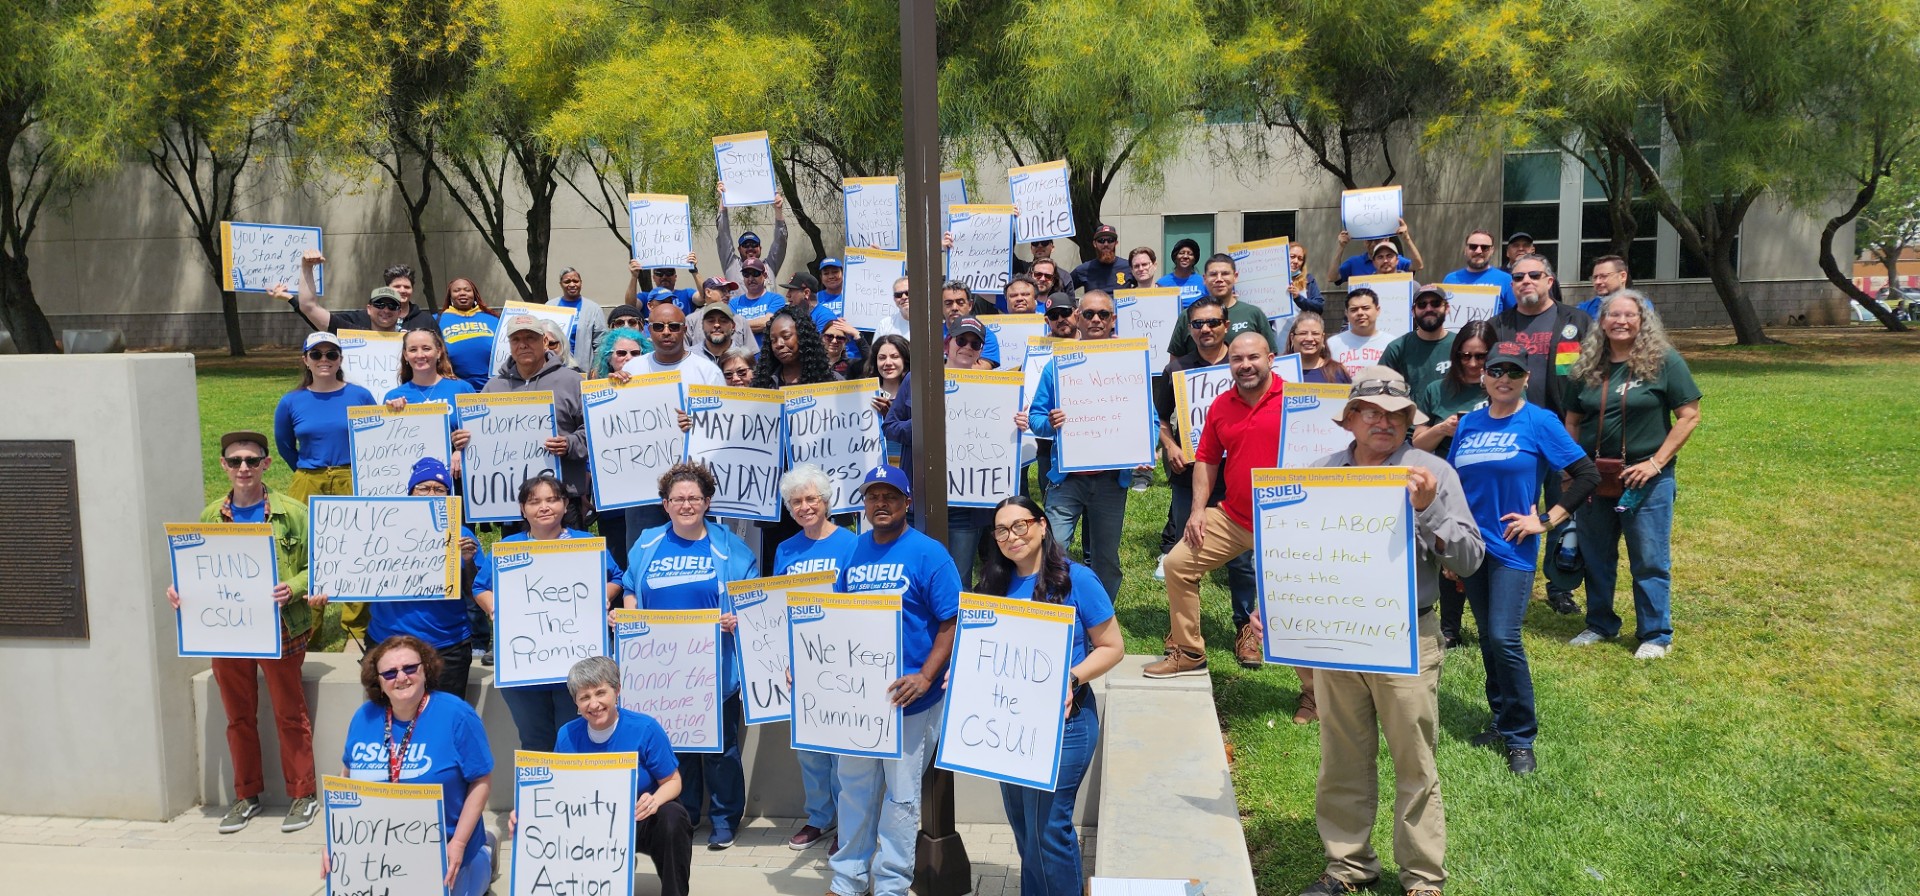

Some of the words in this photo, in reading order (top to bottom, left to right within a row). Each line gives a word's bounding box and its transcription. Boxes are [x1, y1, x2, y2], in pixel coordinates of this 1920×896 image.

[1026, 196, 1042, 211] the
[284, 232, 308, 246] got
[654, 229, 672, 242] the
[850, 231, 895, 248] UNITE!
[972, 230, 1002, 241] honor
[860, 269, 882, 283] The
[855, 283, 888, 300] People
[442, 321, 488, 337] CSUEU
[1130, 310, 1165, 330] Power
[1056, 352, 1084, 362] CSUEU
[366, 374, 390, 388] the
[1060, 374, 1082, 387] The
[1090, 370, 1144, 387] Working
[584, 388, 614, 400] CSUEU
[690, 396, 720, 404] CSUEU
[1110, 395, 1129, 403] the
[1285, 394, 1317, 404] CSUEU
[460, 405, 487, 414] CSUEU
[948, 402, 1001, 420] orkers
[1112, 413, 1122, 421] of
[351, 416, 380, 426] CSUEU
[388, 418, 420, 440] The
[482, 414, 556, 434] Workers
[602, 403, 672, 438] UNION
[692, 410, 734, 441] MAY
[740, 413, 781, 444] DAY!
[964, 428, 990, 439] the
[356, 442, 426, 462] Working
[493, 440, 518, 466] the
[601, 438, 682, 474] STRONG
[948, 466, 1011, 496] NITE!
[1254, 474, 1286, 482] California
[1288, 474, 1307, 482] State
[1308, 473, 1344, 483] University
[1346, 473, 1386, 482] Employees
[1257, 484, 1302, 500] CSUEU
[437, 499, 448, 530] CSUEU
[1296, 519, 1310, 530] is
[1320, 514, 1397, 534] LABOR
[171, 533, 201, 543] CSUEU
[313, 534, 347, 561] got
[363, 533, 389, 558] to
[496, 552, 529, 565] CSUEU
[648, 556, 712, 572] CSUEU
[1264, 546, 1322, 561] indeed
[1330, 548, 1372, 564] that
[196, 553, 260, 580] FUND
[314, 560, 342, 582] for
[786, 558, 836, 575] CSUEU
[847, 564, 904, 583] CSUEU
[376, 574, 398, 597] fall
[402, 572, 428, 595] for
[1308, 571, 1340, 584] the
[217, 584, 245, 602] the
[524, 574, 588, 618] Keep
[732, 590, 763, 602] CSUEU
[1268, 590, 1366, 607] difference
[1375, 598, 1400, 610] on
[790, 605, 821, 615] CSUEU
[961, 610, 994, 620] CSUEU
[524, 610, 579, 635] The
[617, 622, 646, 630] CSUEU
[510, 635, 598, 670] Promise
[620, 638, 677, 666] Today
[800, 632, 836, 664] We
[848, 640, 896, 680] Keep
[977, 638, 1052, 683] FUND
[622, 666, 680, 691] honor
[685, 666, 716, 690] the
[704, 692, 714, 711] of
[992, 684, 1020, 714] the
[802, 692, 892, 748] Running!
[516, 755, 539, 763] California
[585, 758, 616, 766] Employees
[518, 767, 549, 777] CSUEU
[326, 790, 358, 800] CSUEU
[534, 787, 616, 838] Equity
[332, 813, 442, 846] Workers
[525, 825, 627, 873] Solidarity
[360, 852, 408, 882] the
[531, 865, 611, 896] Action
